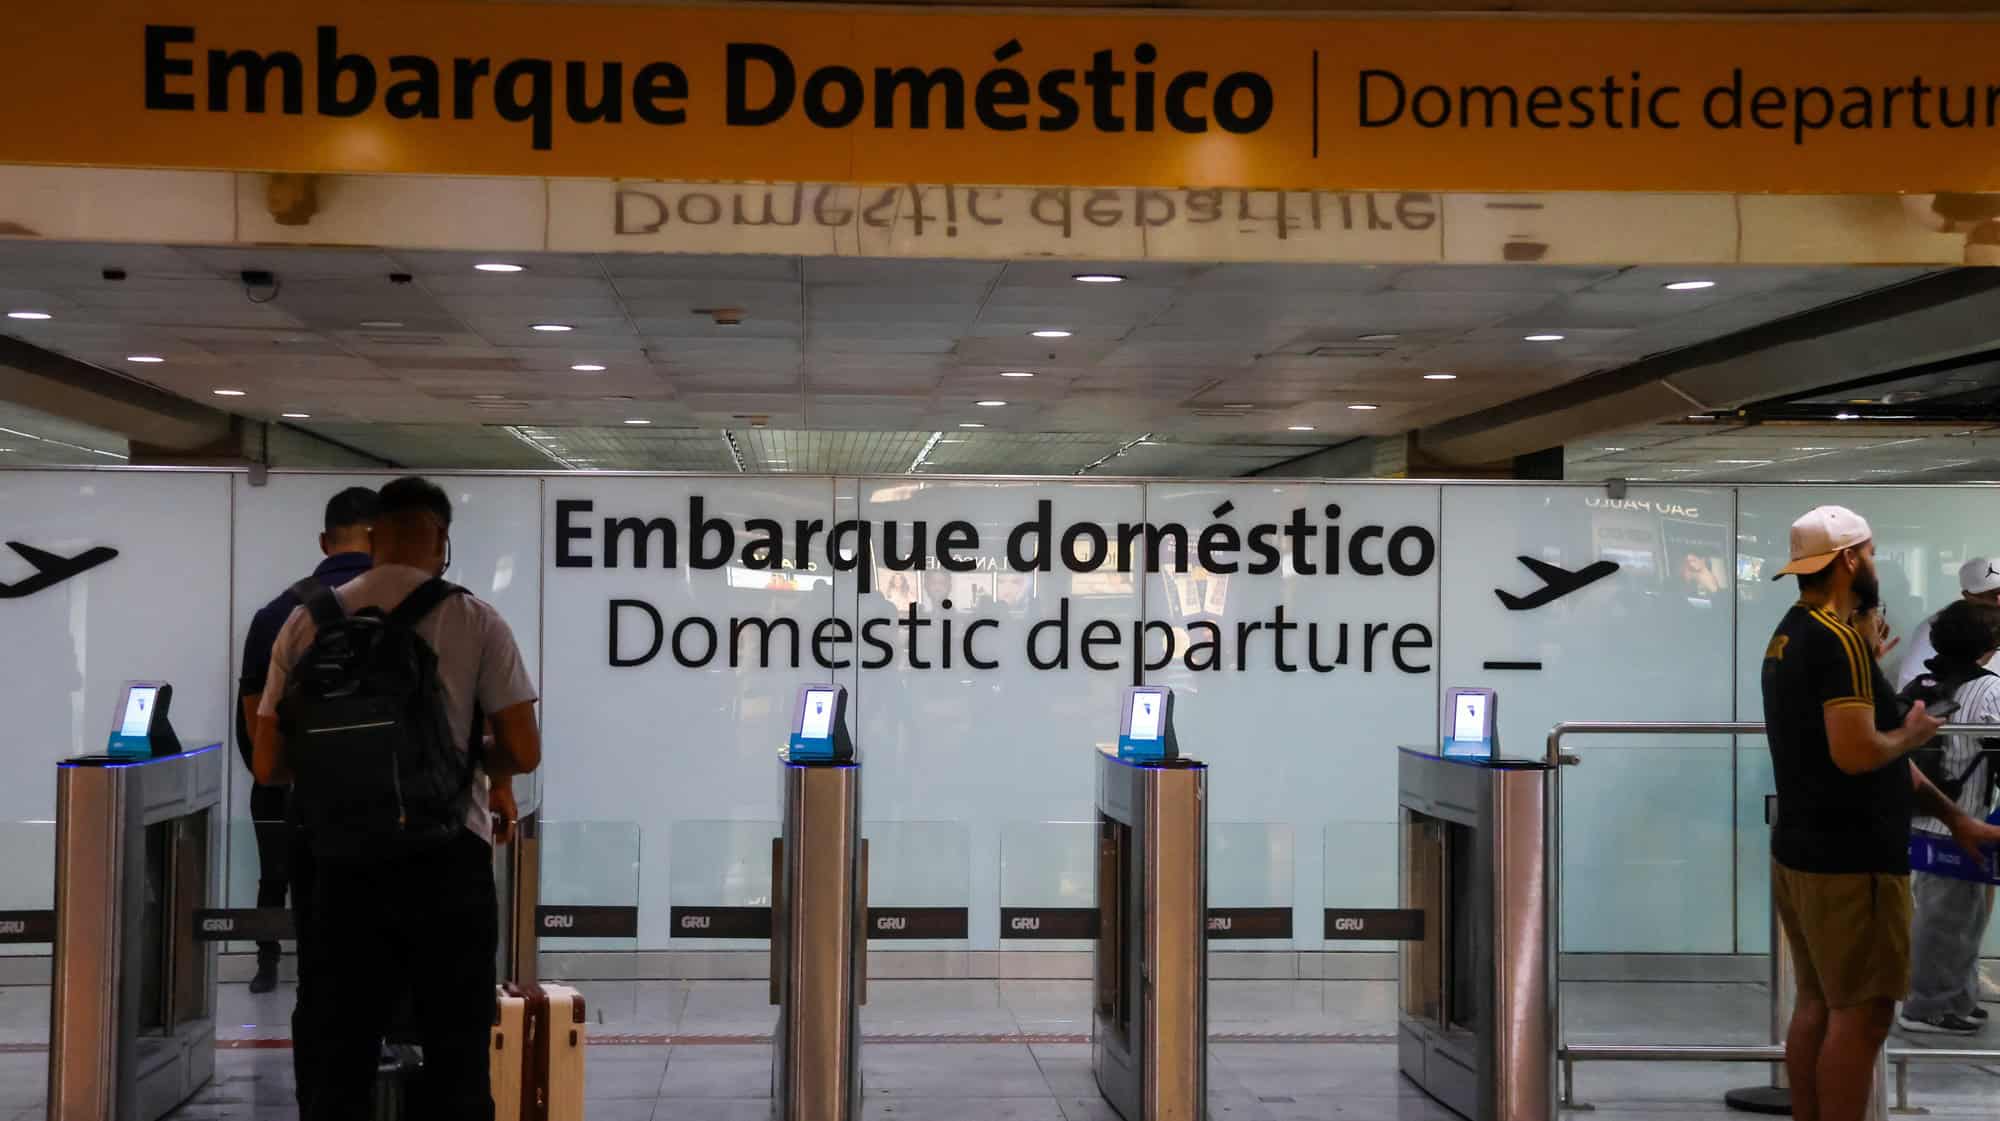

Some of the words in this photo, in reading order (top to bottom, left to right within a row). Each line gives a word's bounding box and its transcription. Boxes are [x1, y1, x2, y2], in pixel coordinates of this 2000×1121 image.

[144, 24, 689, 150] Embarque
[726, 39, 1273, 133] Doméstico
[1359, 69, 1680, 129] Domestic
[555, 495, 980, 594] Embarque
[1006, 499, 1436, 577] doméstico
[608, 598, 1001, 669] Domestic
[1026, 597, 1434, 684] departure
[202, 918, 234, 931] GRU
[544, 914, 574, 928] GRU
[681, 915, 711, 929] GRU
[877, 917, 906, 930] GRU
[1011, 917, 1040, 930] GRU
[1335, 918, 1364, 931] GRU
